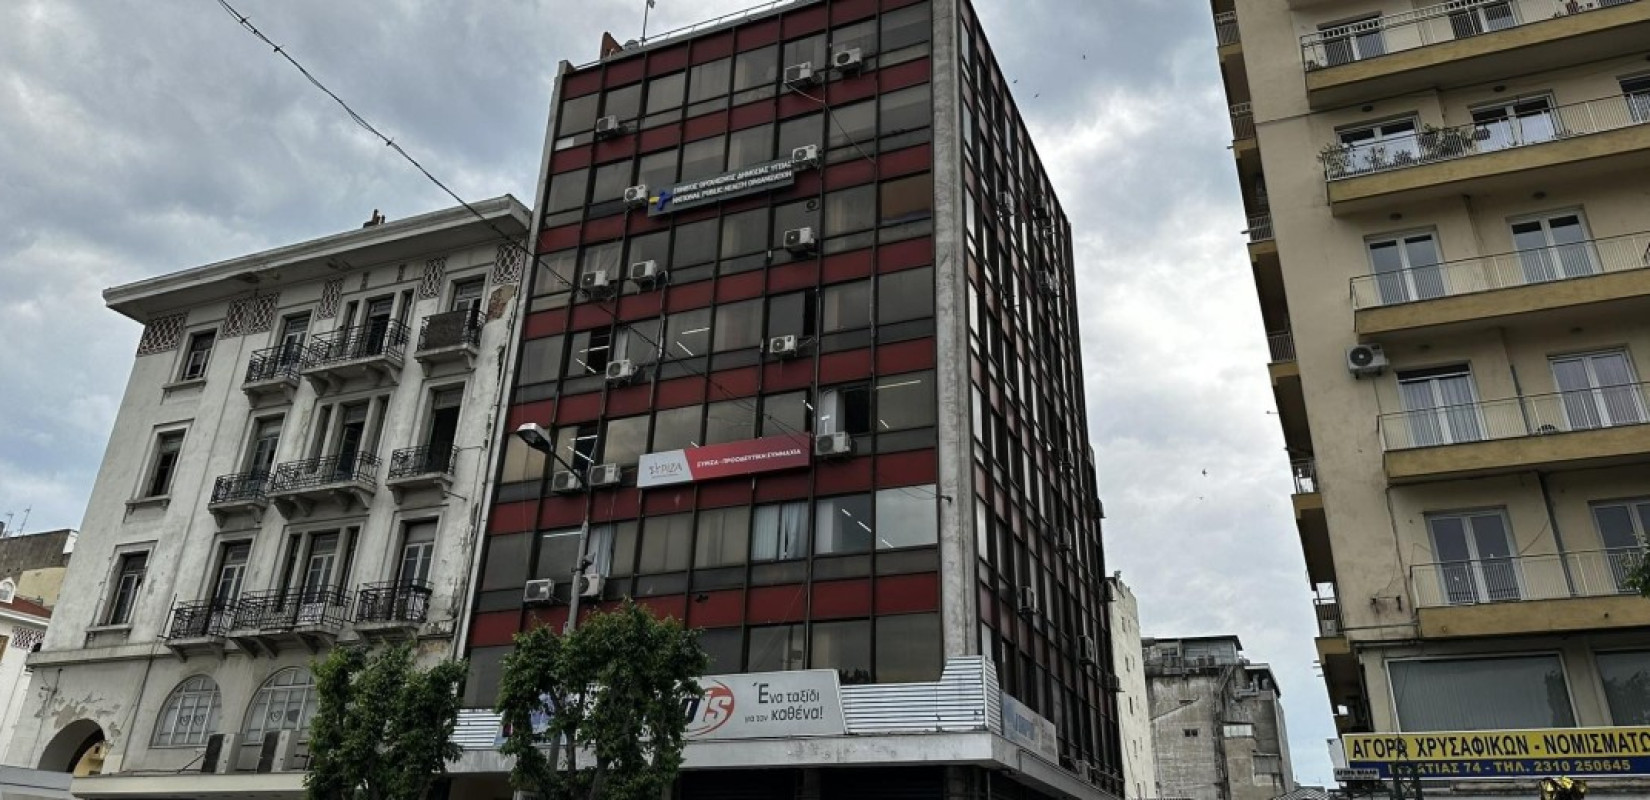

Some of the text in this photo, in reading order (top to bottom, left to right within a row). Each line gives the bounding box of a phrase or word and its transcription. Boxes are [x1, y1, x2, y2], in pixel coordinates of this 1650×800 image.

[672, 171, 792, 204] NATIONAL PUBLIC HEALTH ORGANIZATION
[752, 682, 783, 704] Ένα
[786, 688, 820, 705] ταξίδι
[771, 705, 823, 721] καθένα!
[1353, 738, 1408, 758] ΑΓΟΡΑ
[1415, 735, 1529, 758] ΧΡΥΣΑΦΙΚΩΝ
[1463, 762, 1482, 774] 74
[1493, 761, 1530, 773] ΤΗΛ.
[1534, 760, 1571, 772] 2310
[1574, 759, 1631, 772] 250645
